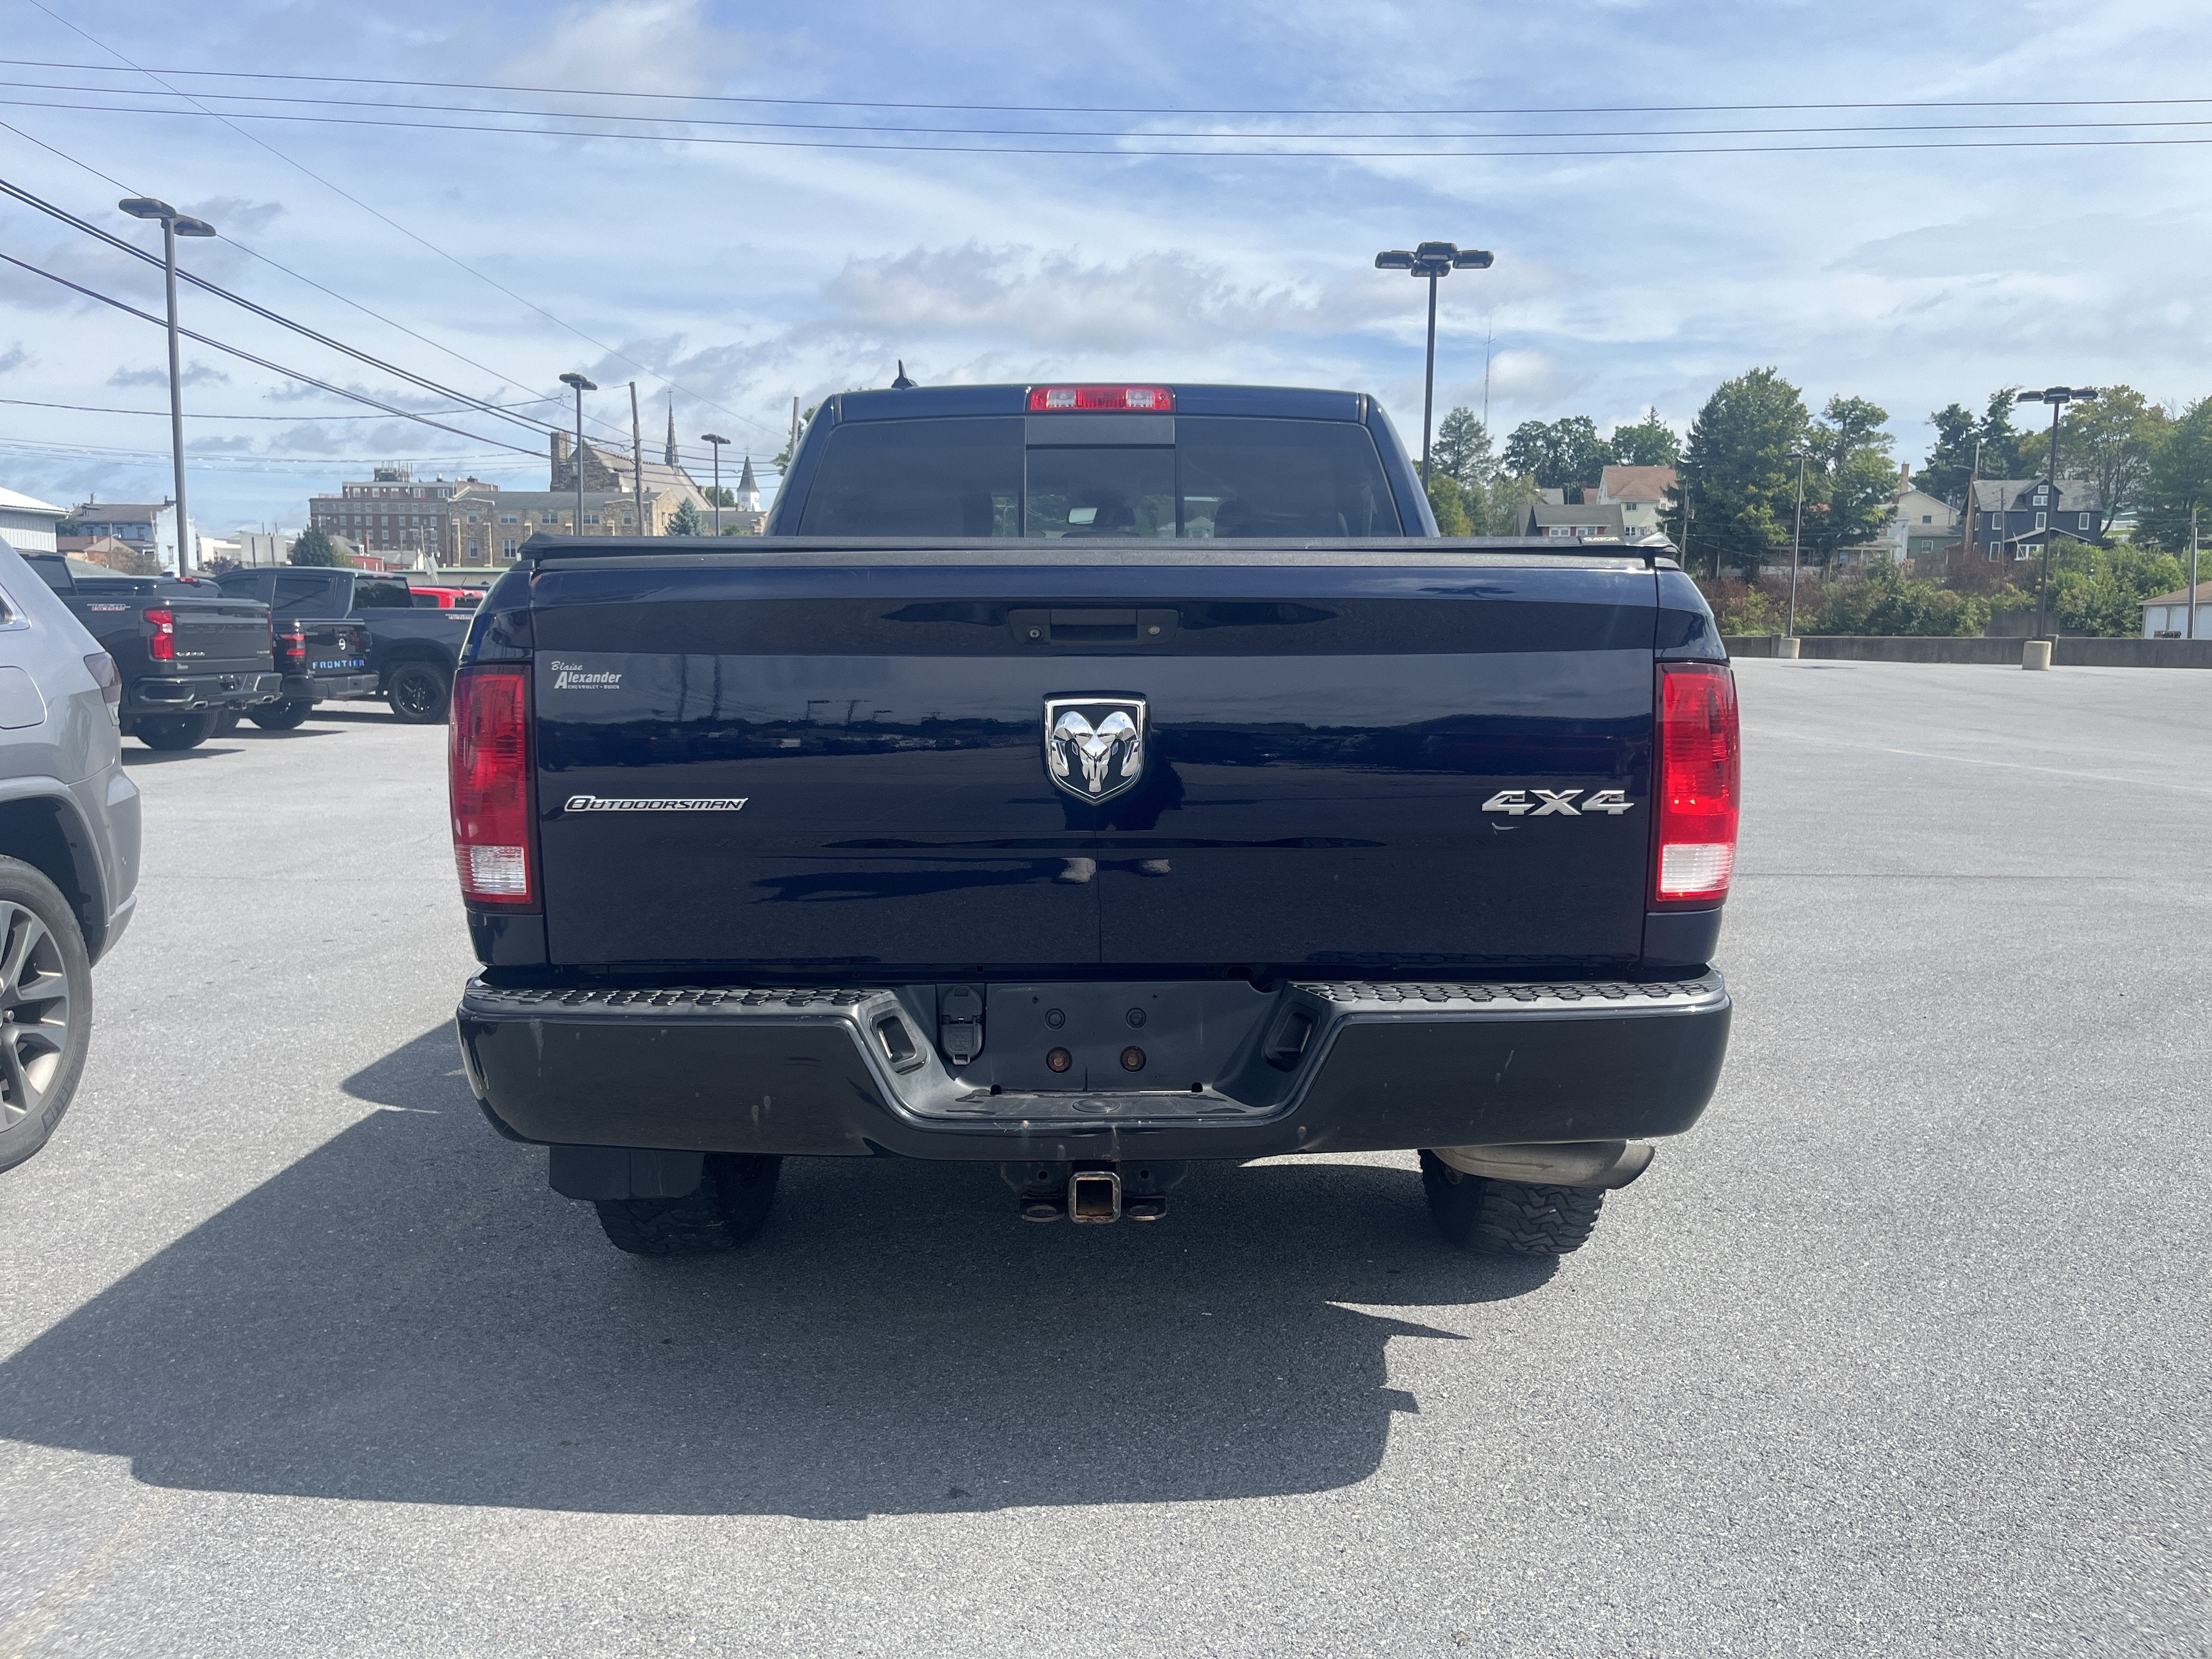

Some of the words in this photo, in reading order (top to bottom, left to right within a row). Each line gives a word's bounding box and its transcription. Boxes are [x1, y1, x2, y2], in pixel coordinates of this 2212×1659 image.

[312, 659, 364, 669] FRONTIER
[551, 661, 583, 671] Blaise
[554, 672, 622, 689] Alexander
[565, 795, 744, 811] OUTDOORSMAN
[1482, 789, 1634, 816] 4X4
